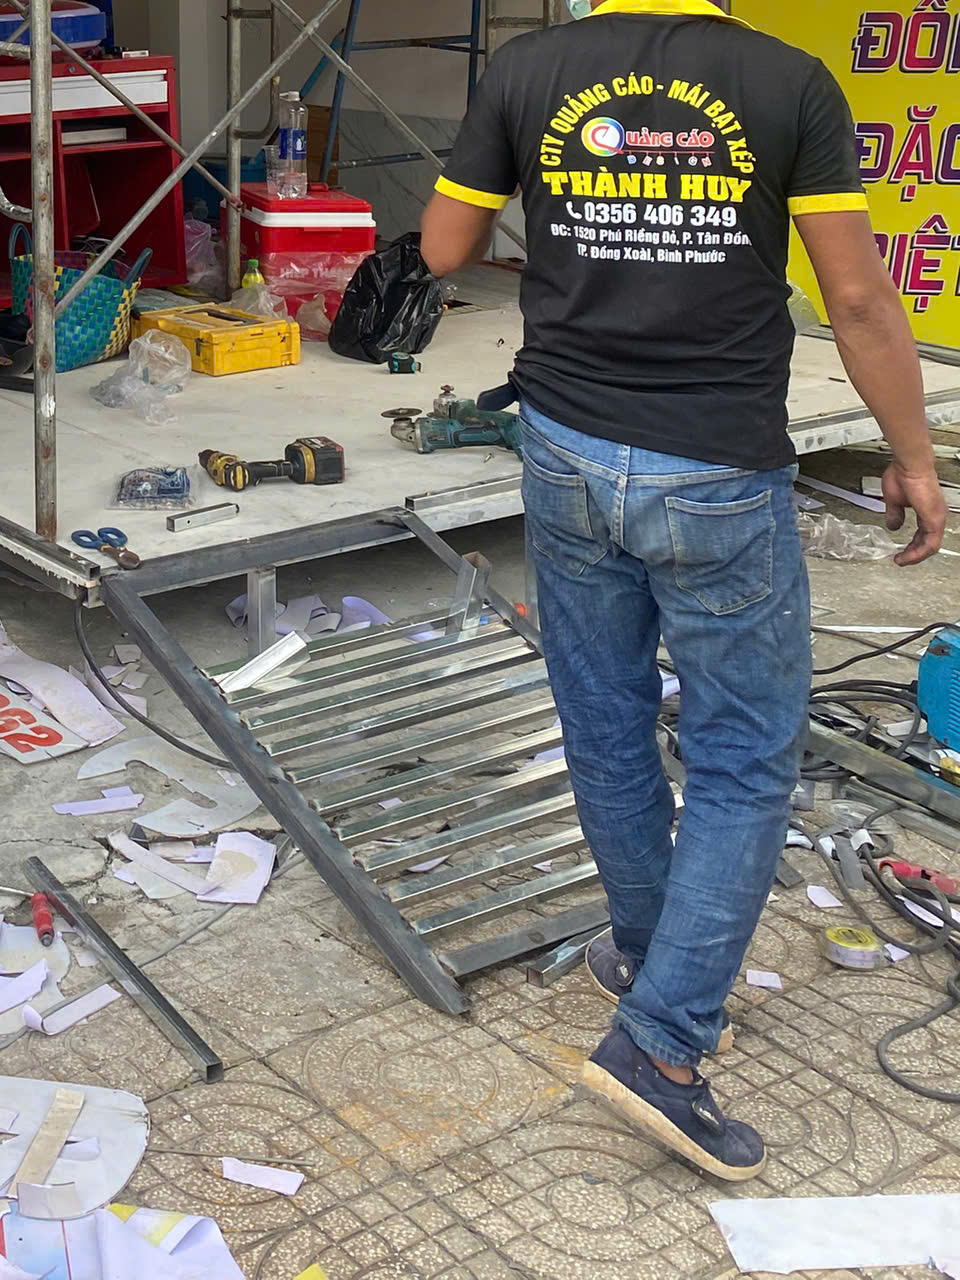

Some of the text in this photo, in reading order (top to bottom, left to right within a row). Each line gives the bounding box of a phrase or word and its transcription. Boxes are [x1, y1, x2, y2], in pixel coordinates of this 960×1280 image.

[550, 82, 612, 135] QUẢNG
[667, 78, 711, 109] MÁI
[704, 98, 742, 136] BẠT
[540, 132, 565, 167] CTY
[726, 136, 758, 175] XẾP
[541, 166, 753, 203] THÀNH HUY
[583, 201, 738, 227] 0356 406 349
[550, 223, 572, 238] ĐC:
[573, 225, 596, 241] 1520
[599, 228, 622, 243] Phú
[696, 231, 721, 246] Tân
[656, 248, 683, 263] Bình
